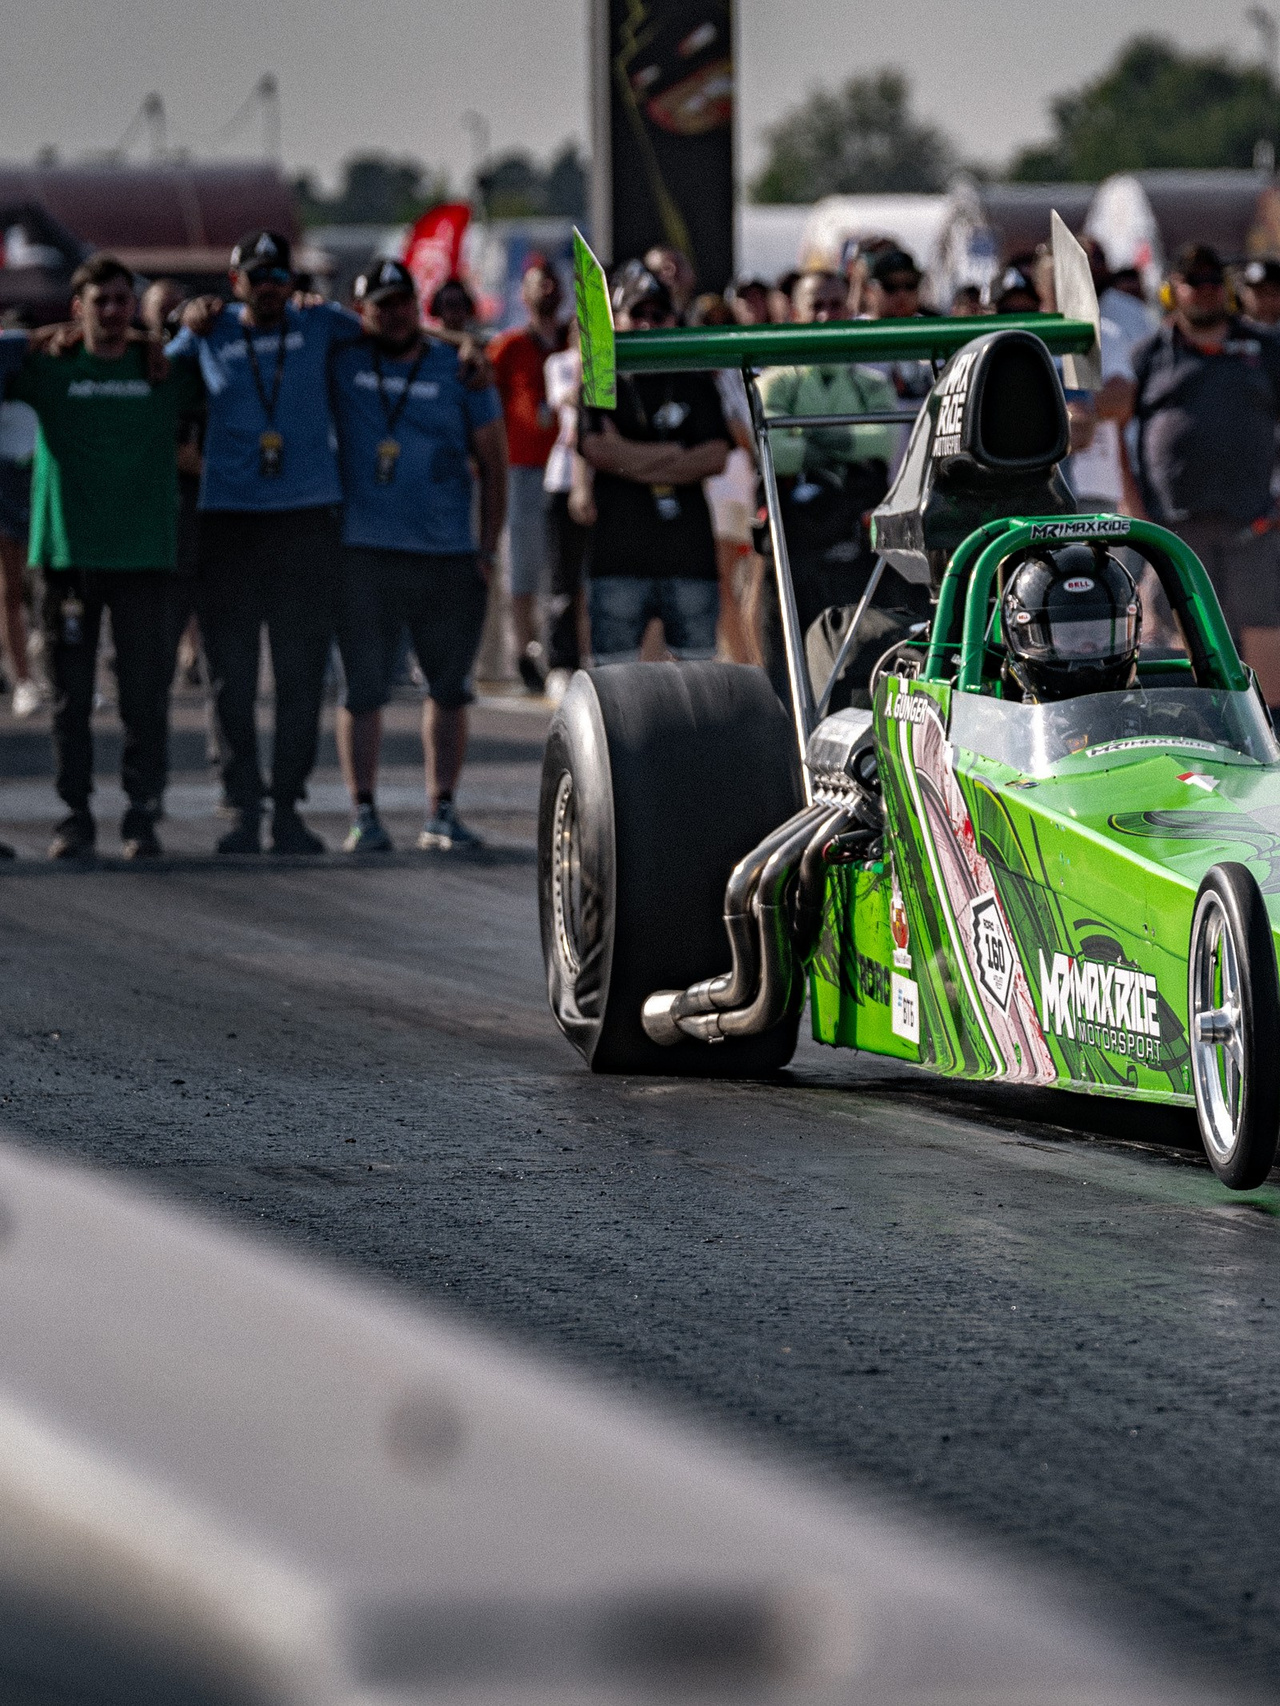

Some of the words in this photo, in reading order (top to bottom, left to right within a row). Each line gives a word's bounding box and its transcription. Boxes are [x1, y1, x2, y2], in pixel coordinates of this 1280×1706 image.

[936, 392, 967, 437] RIDE
[1067, 581, 1090, 589] BELL
[985, 933, 1006, 975] 160
[1078, 1020, 1161, 1062] MOTORSPORT
